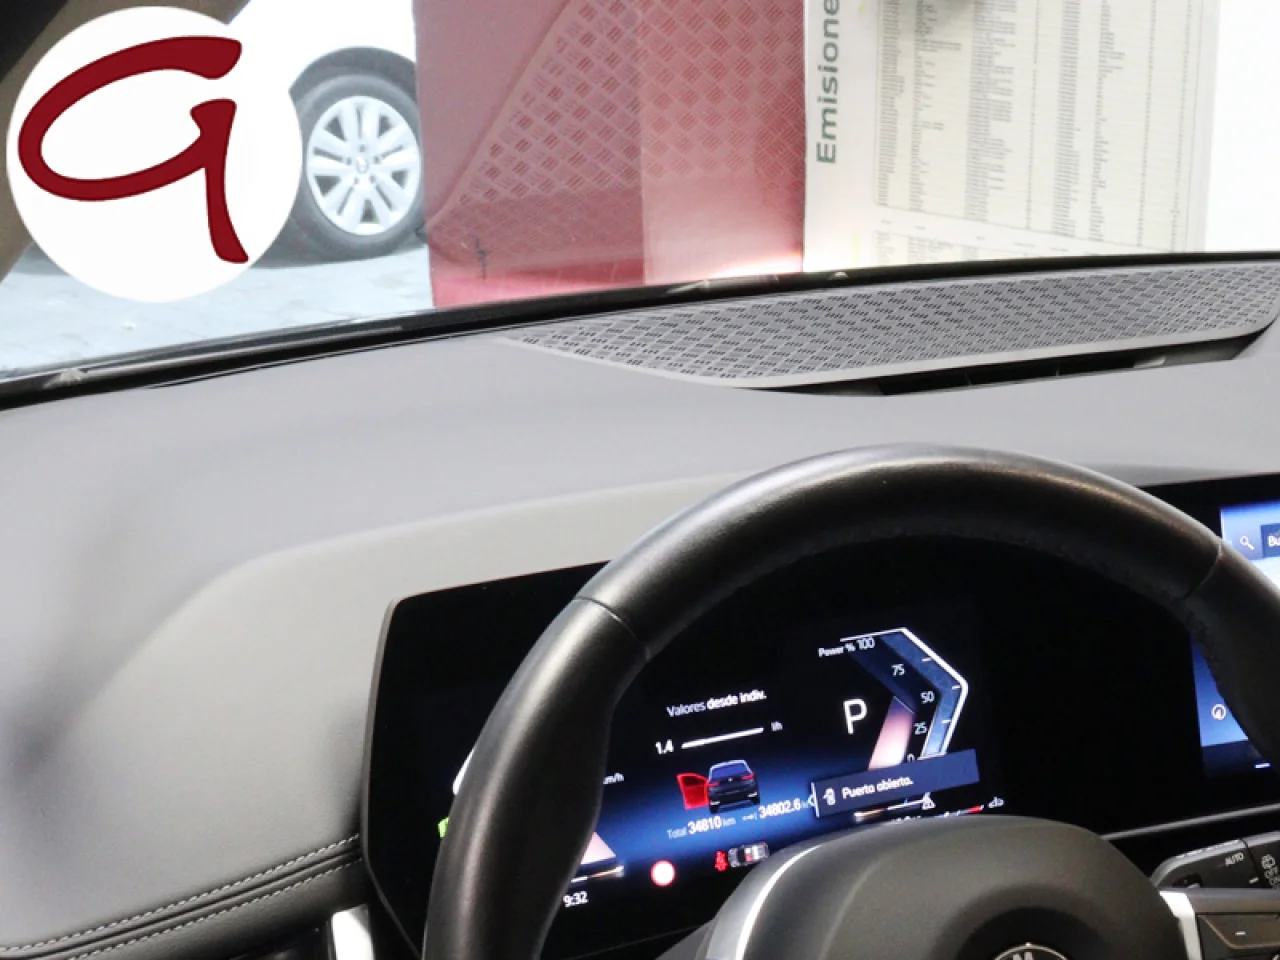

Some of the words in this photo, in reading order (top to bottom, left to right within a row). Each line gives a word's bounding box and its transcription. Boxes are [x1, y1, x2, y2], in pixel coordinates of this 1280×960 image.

[818, 646, 844, 658] Power
[856, 636, 876, 650] 100
[891, 663, 905, 676] 75
[666, 702, 706, 717] Valores
[706, 694, 738, 710] desde
[739, 689, 767, 703] indiv.
[920, 691, 935, 703] 50
[843, 698, 868, 734] P
[914, 722, 927, 735] 25
[655, 739, 674, 755] 1.4
[602, 772, 625, 785] m/h
[758, 798, 801, 819] 34802.6
[667, 826, 688, 839] Total
[687, 816, 722, 835] 34810
[563, 891, 589, 907] 9:32
